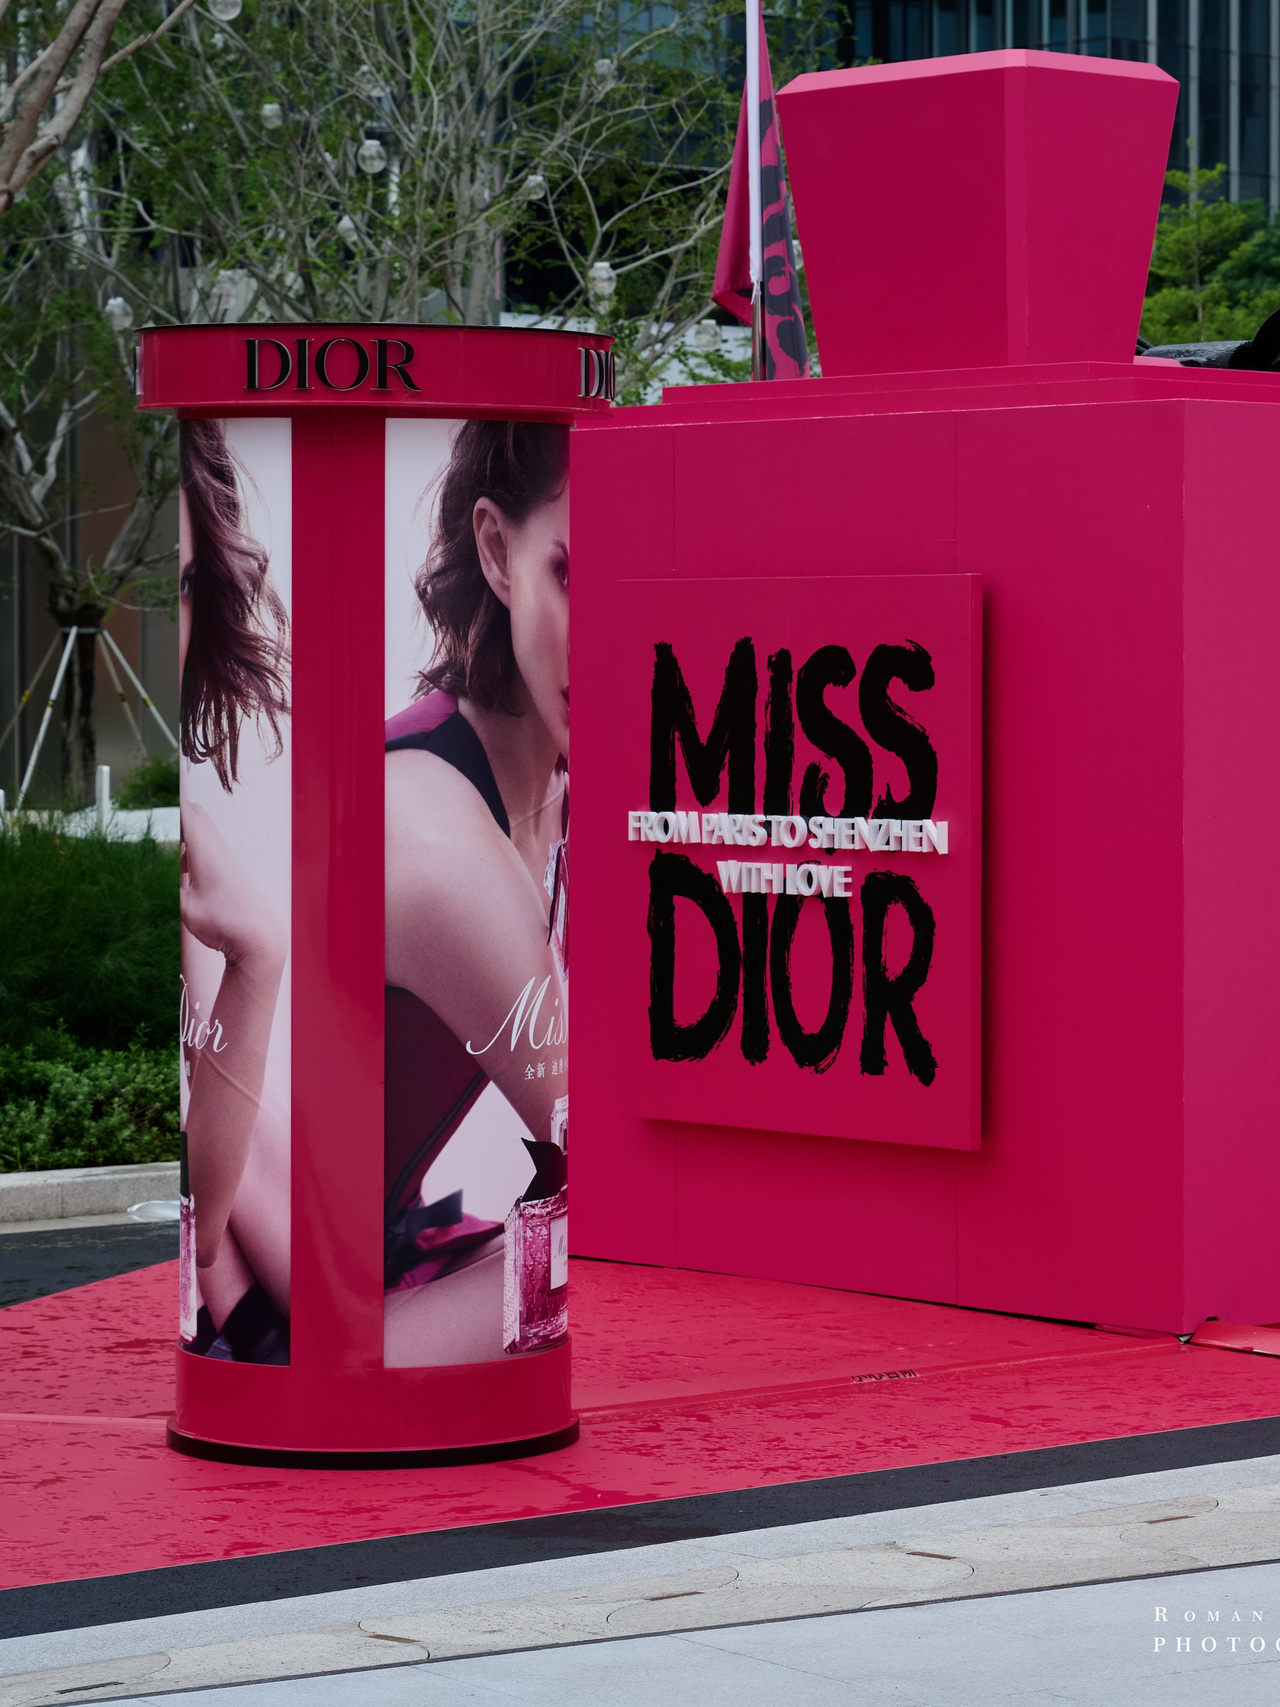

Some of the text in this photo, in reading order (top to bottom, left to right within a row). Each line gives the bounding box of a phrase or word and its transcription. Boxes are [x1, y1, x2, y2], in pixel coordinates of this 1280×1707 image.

[242, 337, 423, 392] DIOR
[649, 636, 938, 855] MISS
[628, 810, 949, 855] FROM PARIS TO SHENZHEN
[716, 859, 852, 898] WITH LOVE
[648, 849, 938, 1087] DIOR
[524, 1062, 546, 1080] 全新
